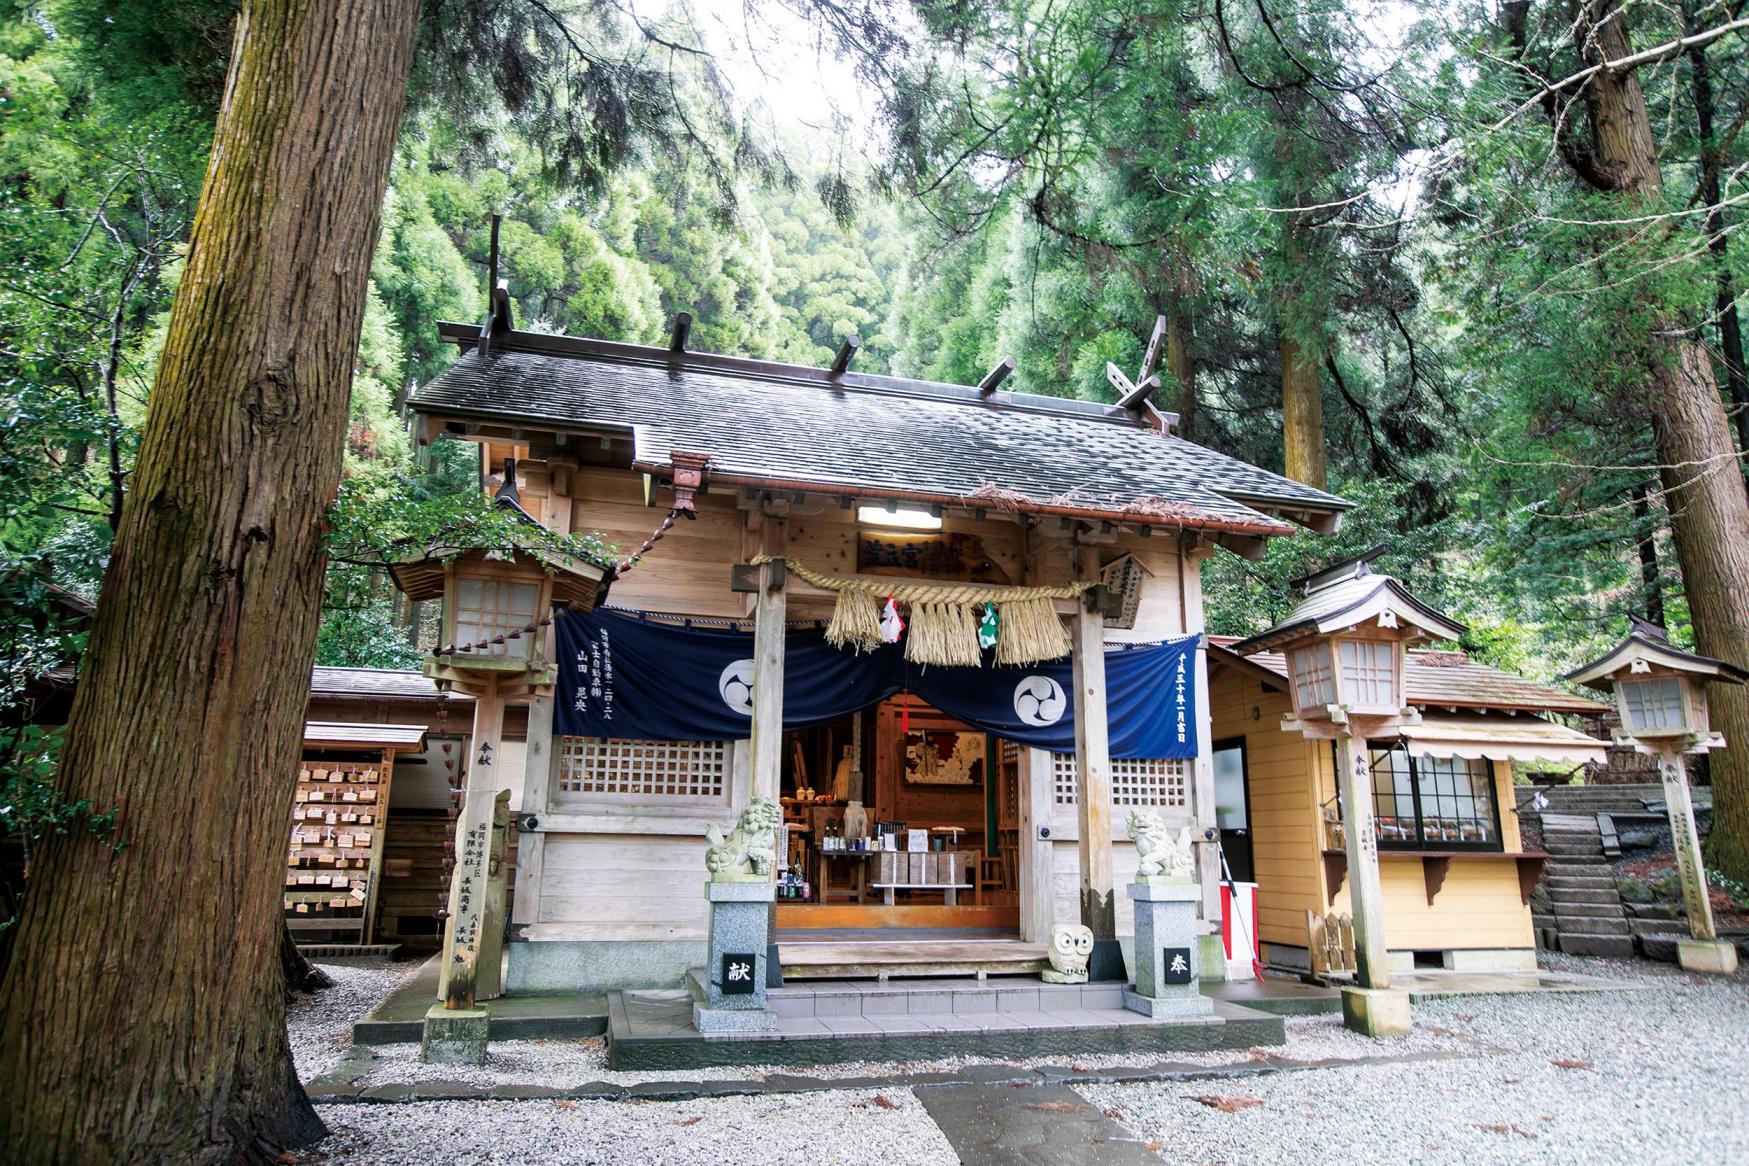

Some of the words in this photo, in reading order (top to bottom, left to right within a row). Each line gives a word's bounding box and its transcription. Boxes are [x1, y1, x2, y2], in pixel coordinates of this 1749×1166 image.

[577, 650, 588, 674] 山田
[478, 742, 493, 766] 奉献
[1355, 754, 1368, 777] 奉献
[1665, 763, 1680, 784] 奉献
[464, 830, 478, 866] 有限会社
[474, 822, 487, 878] 福岡市博多区
[467, 913, 478, 952] 代表取締役
[728, 962, 751, 981] 献
[1170, 953, 1188, 975] 奉
